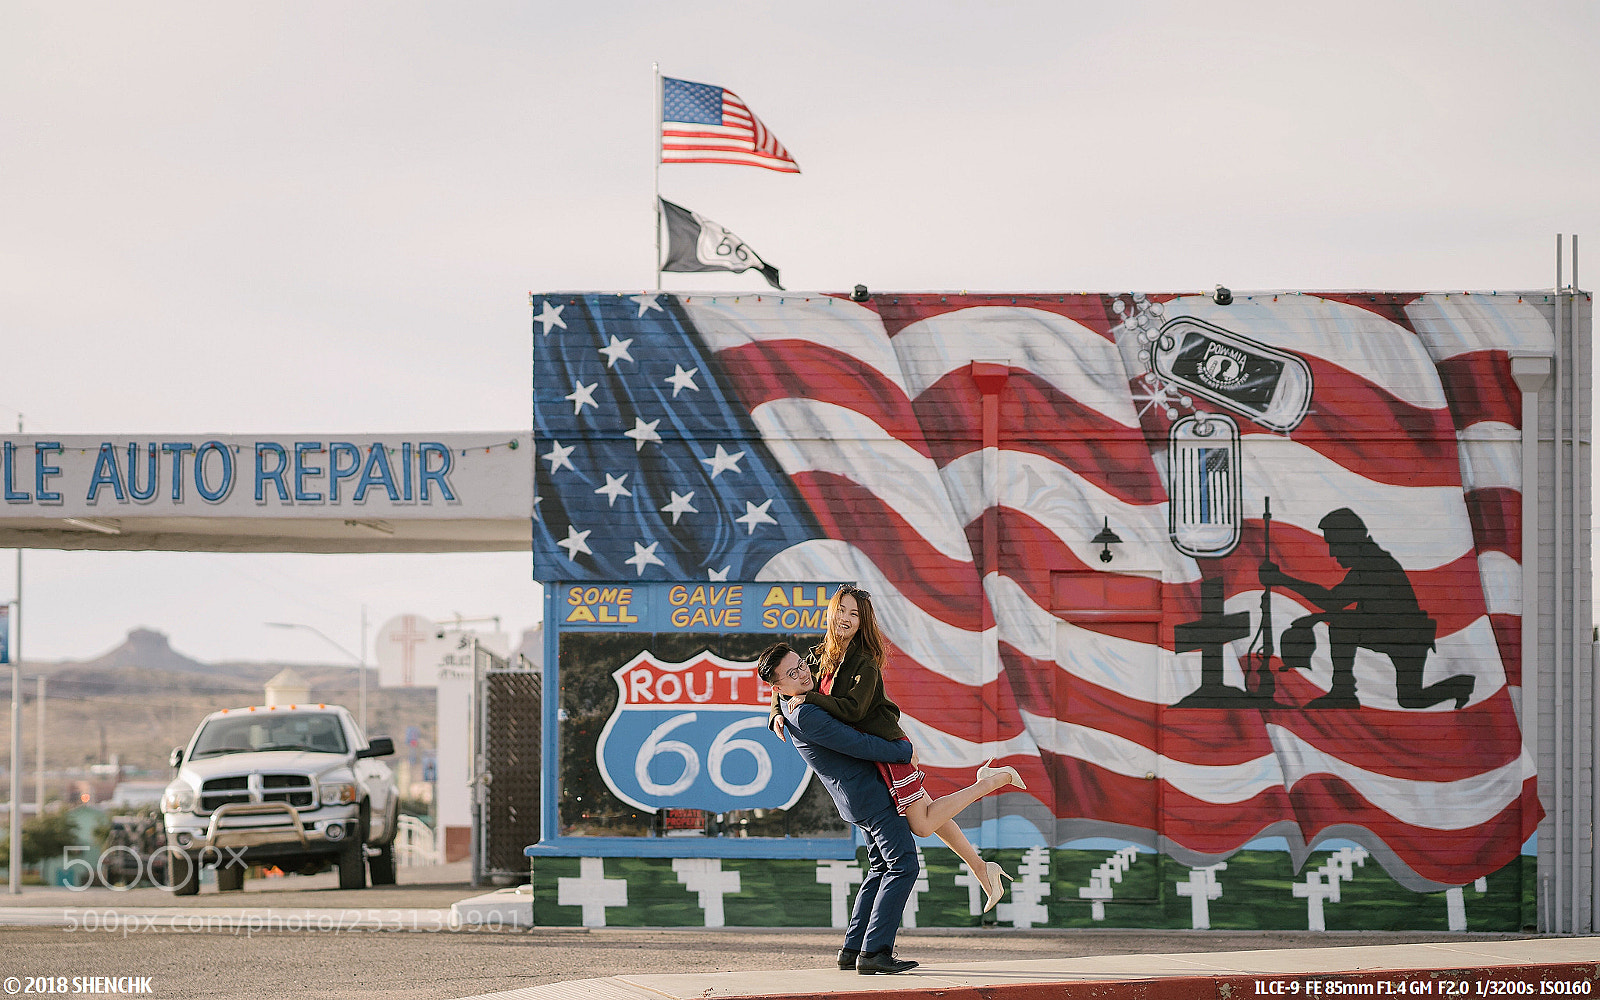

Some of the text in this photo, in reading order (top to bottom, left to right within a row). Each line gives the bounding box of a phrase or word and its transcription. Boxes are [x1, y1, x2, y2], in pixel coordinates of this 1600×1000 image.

[716, 236, 748, 262] 66
[86, 440, 236, 504] AUTO
[253, 441, 459, 504] REPAIR
[566, 585, 830, 607] SOME GAVE ALL
[566, 605, 829, 630] ALL GAVE SOME
[635, 712, 772, 796] 66
